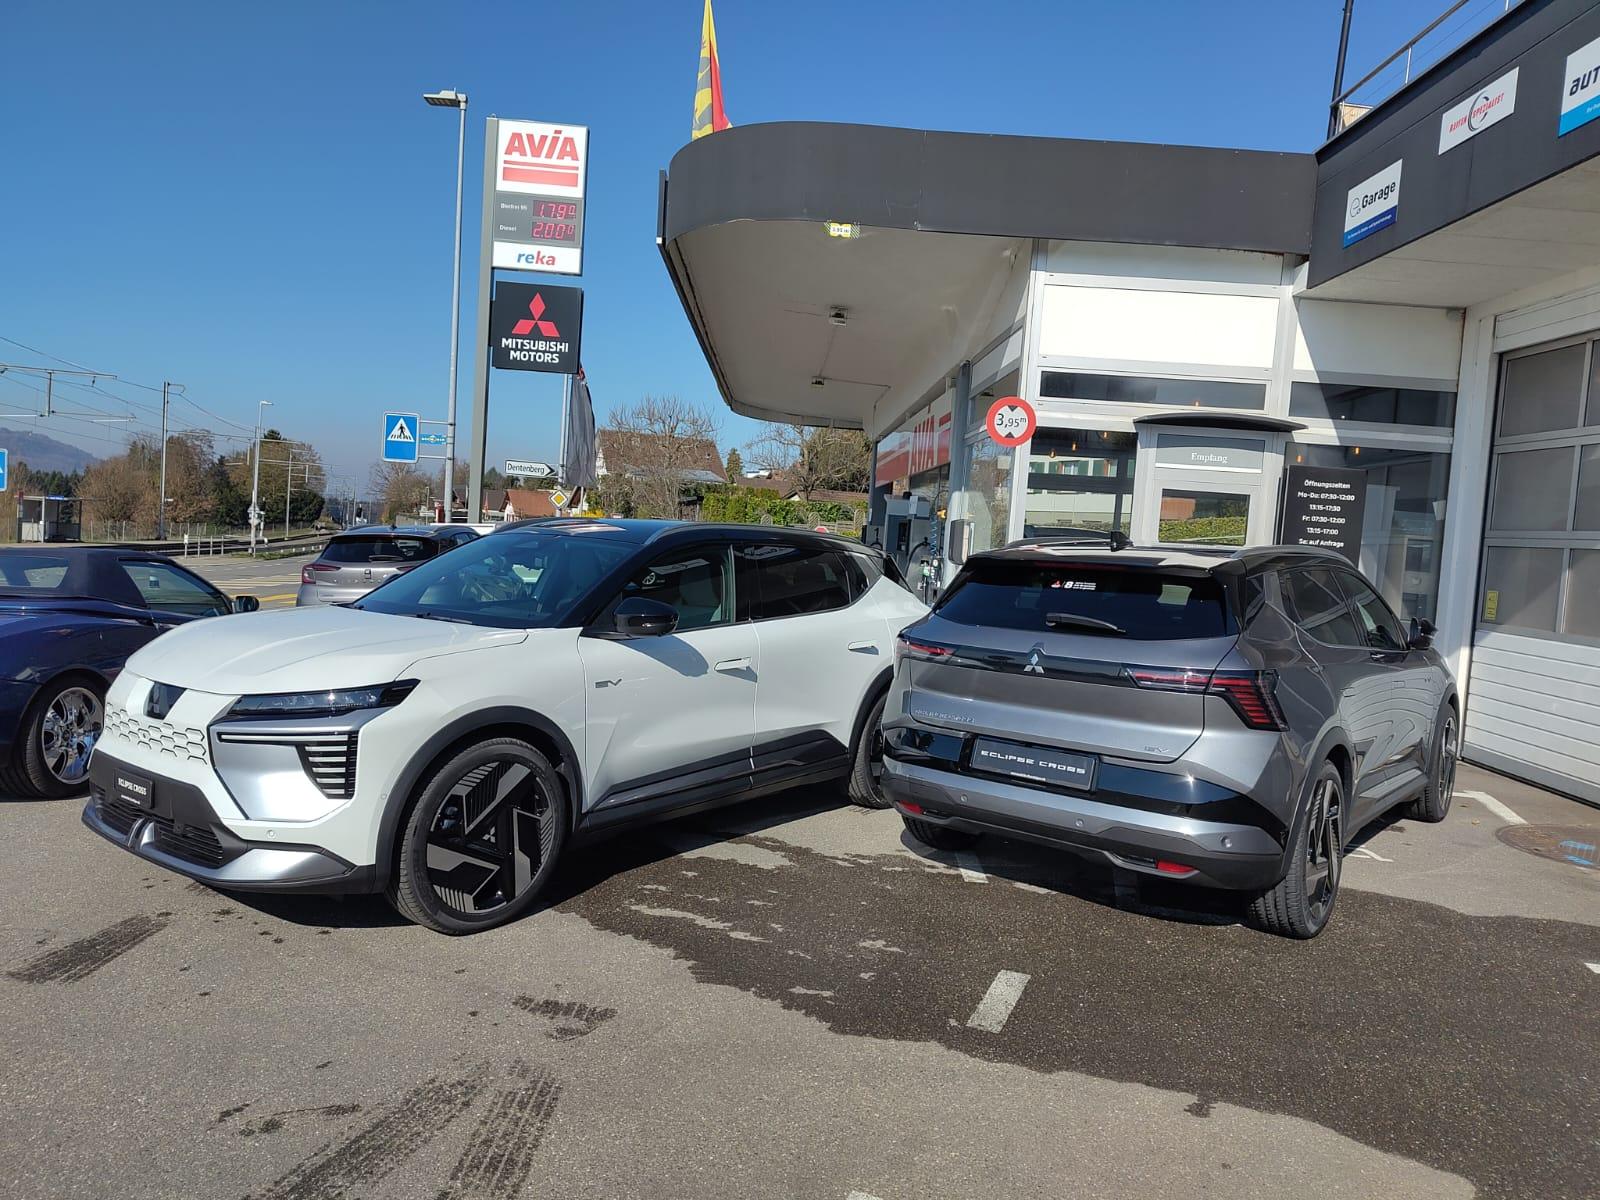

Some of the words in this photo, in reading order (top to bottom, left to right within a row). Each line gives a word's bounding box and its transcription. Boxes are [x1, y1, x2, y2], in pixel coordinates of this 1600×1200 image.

[1472, 92, 1504, 118] SPEZIALIST
[504, 130, 580, 161] AVIA
[1362, 182, 1396, 209] Garage
[500, 224, 517, 232] Diesel
[517, 251, 556, 266] reka
[501, 338, 569, 353] MITSUBISHI
[509, 351, 560, 363] MOTORS
[1191, 453, 1228, 464] Empfang
[508, 463, 545, 475] Dentenberg
[1304, 479, 1351, 489] Öffnungszeiten
[981, 750, 1035, 765] ECLIPSE
[1039, 761, 1086, 774] CROSS
[118, 777, 133, 791] ECLIPSE
[133, 784, 147, 795] CROSS
